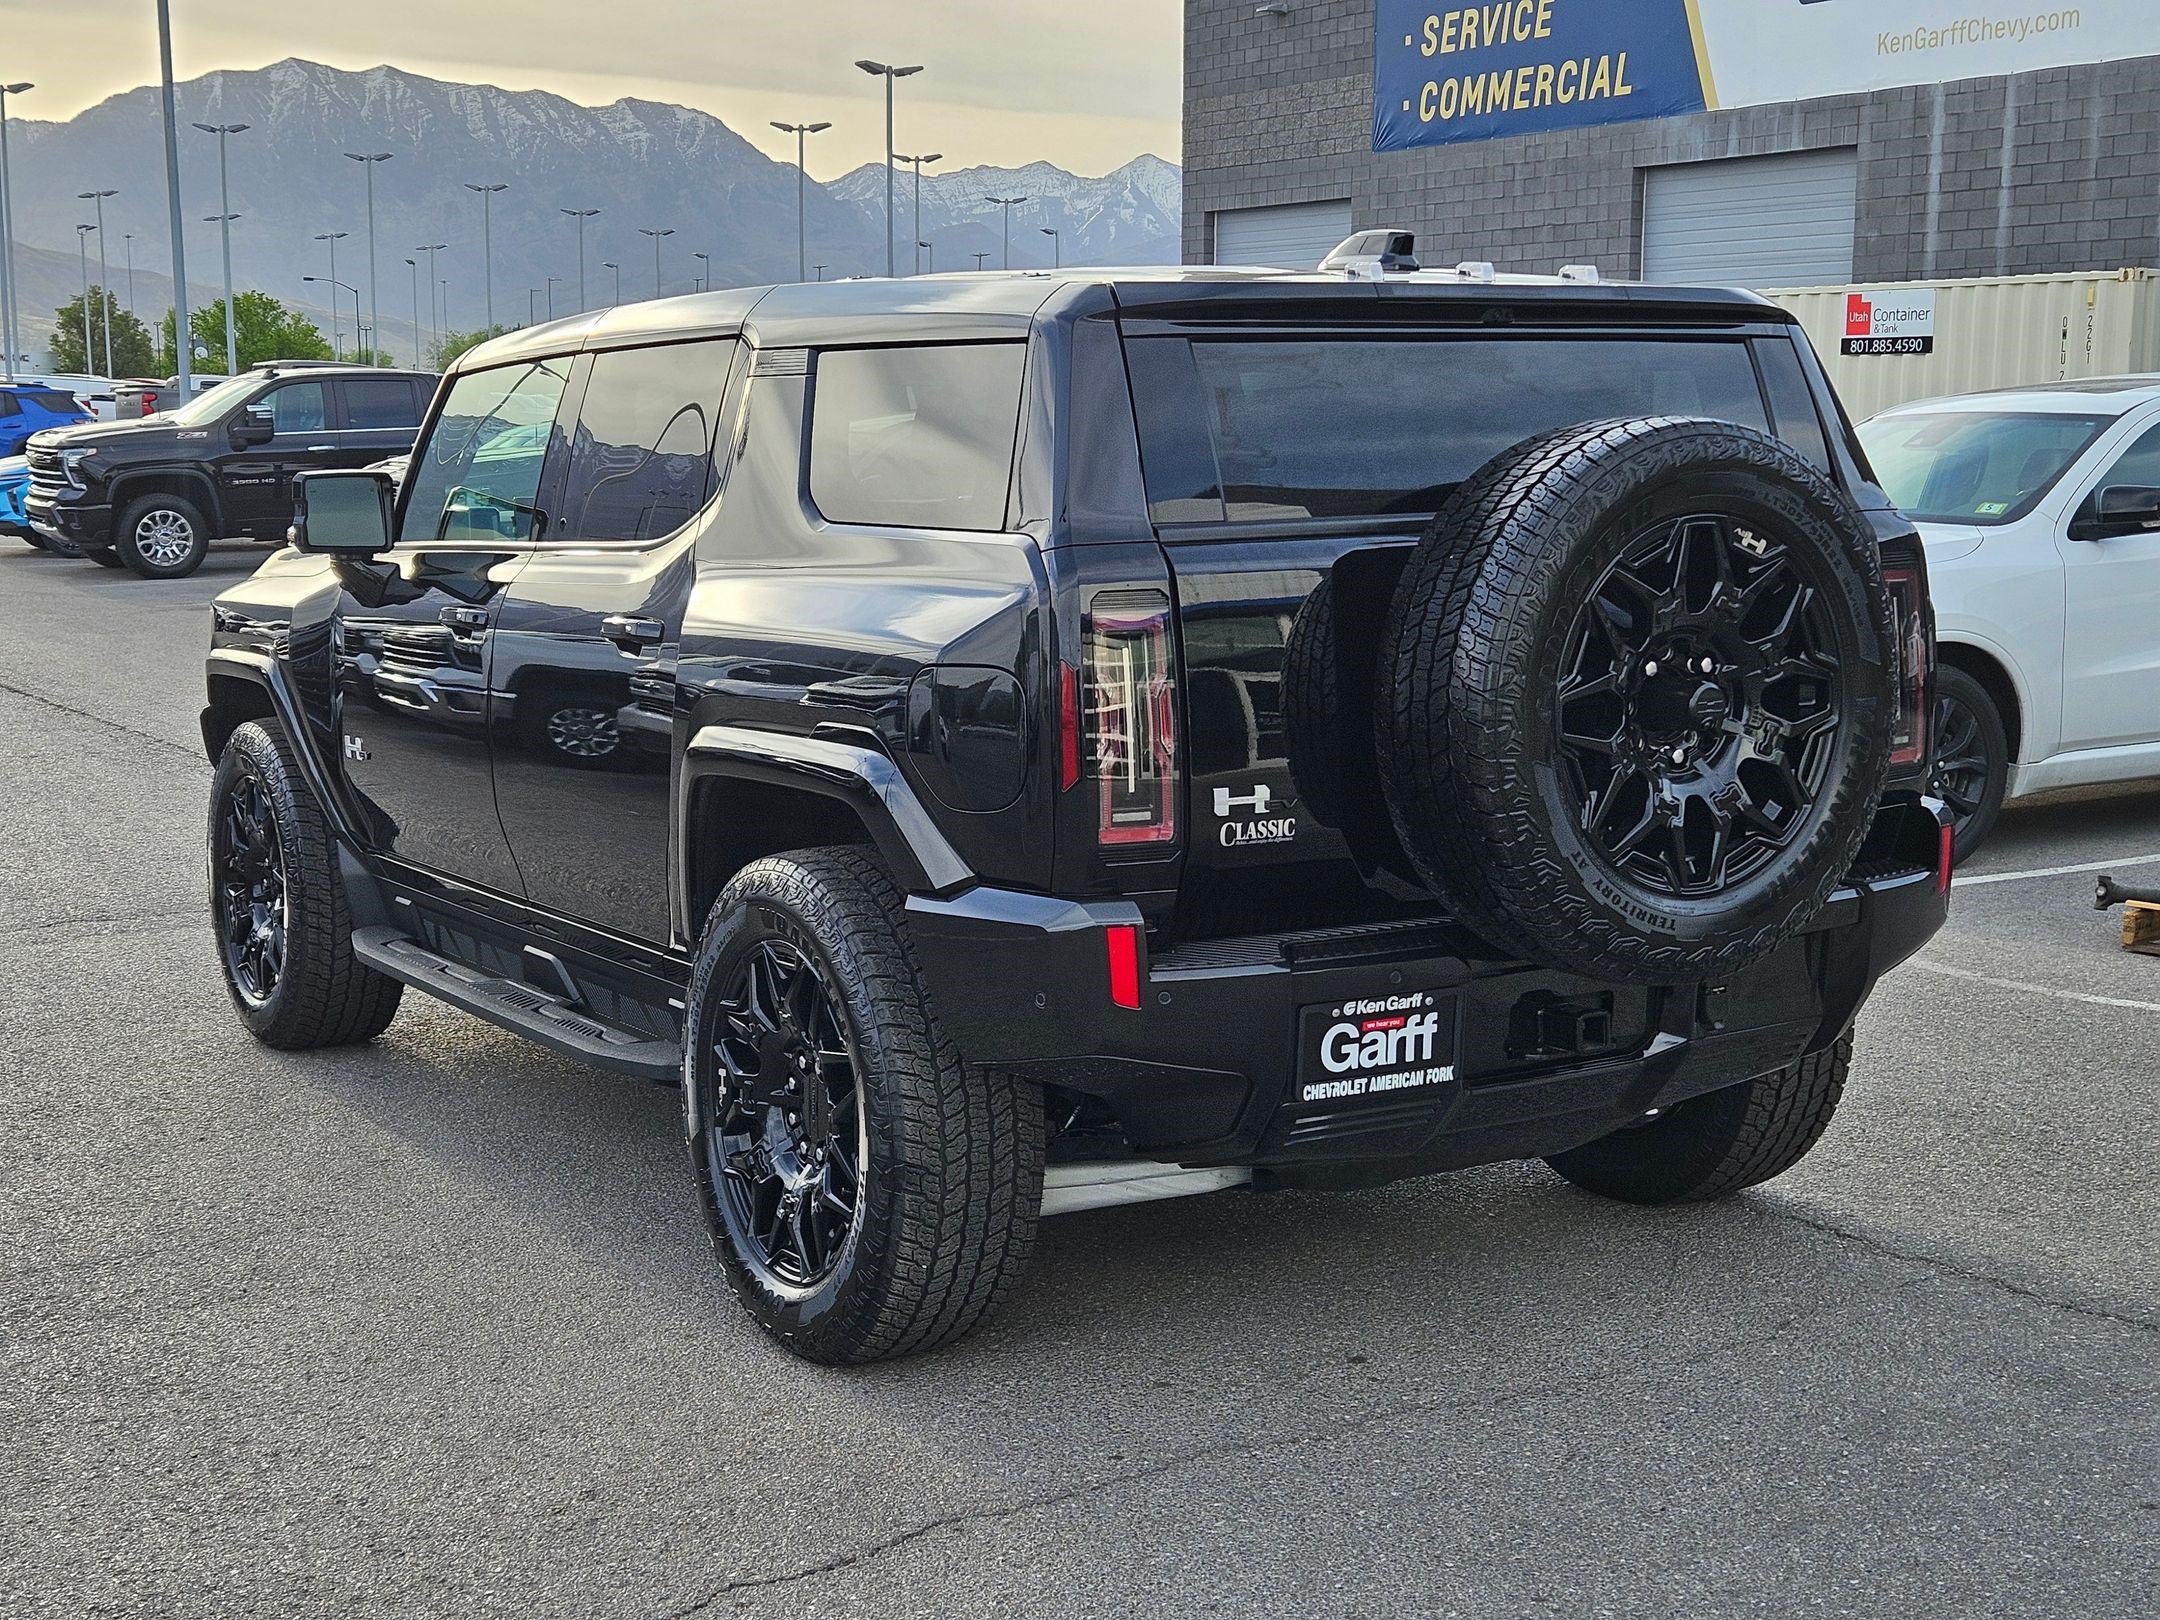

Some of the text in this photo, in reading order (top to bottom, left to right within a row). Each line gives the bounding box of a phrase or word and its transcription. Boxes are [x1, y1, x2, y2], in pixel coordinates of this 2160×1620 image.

[1420, 0, 1552, 57] SERVICE
[1877, 9, 2081, 56] KenGarffChevy.com
[1419, 52, 1633, 123] COMMERCIAL
[1849, 306, 1931, 323] Utah Container
[1881, 323, 1898, 334] Tank
[1849, 338, 1923, 353] 801.885.4590
[1570, 851, 1676, 931] TERRITORY AT
[1356, 992, 1423, 1015] Ken Garff
[1321, 1012, 1438, 1073] Garff
[1303, 1065, 1455, 1101] CHEVROLET AMERICAN FORK
